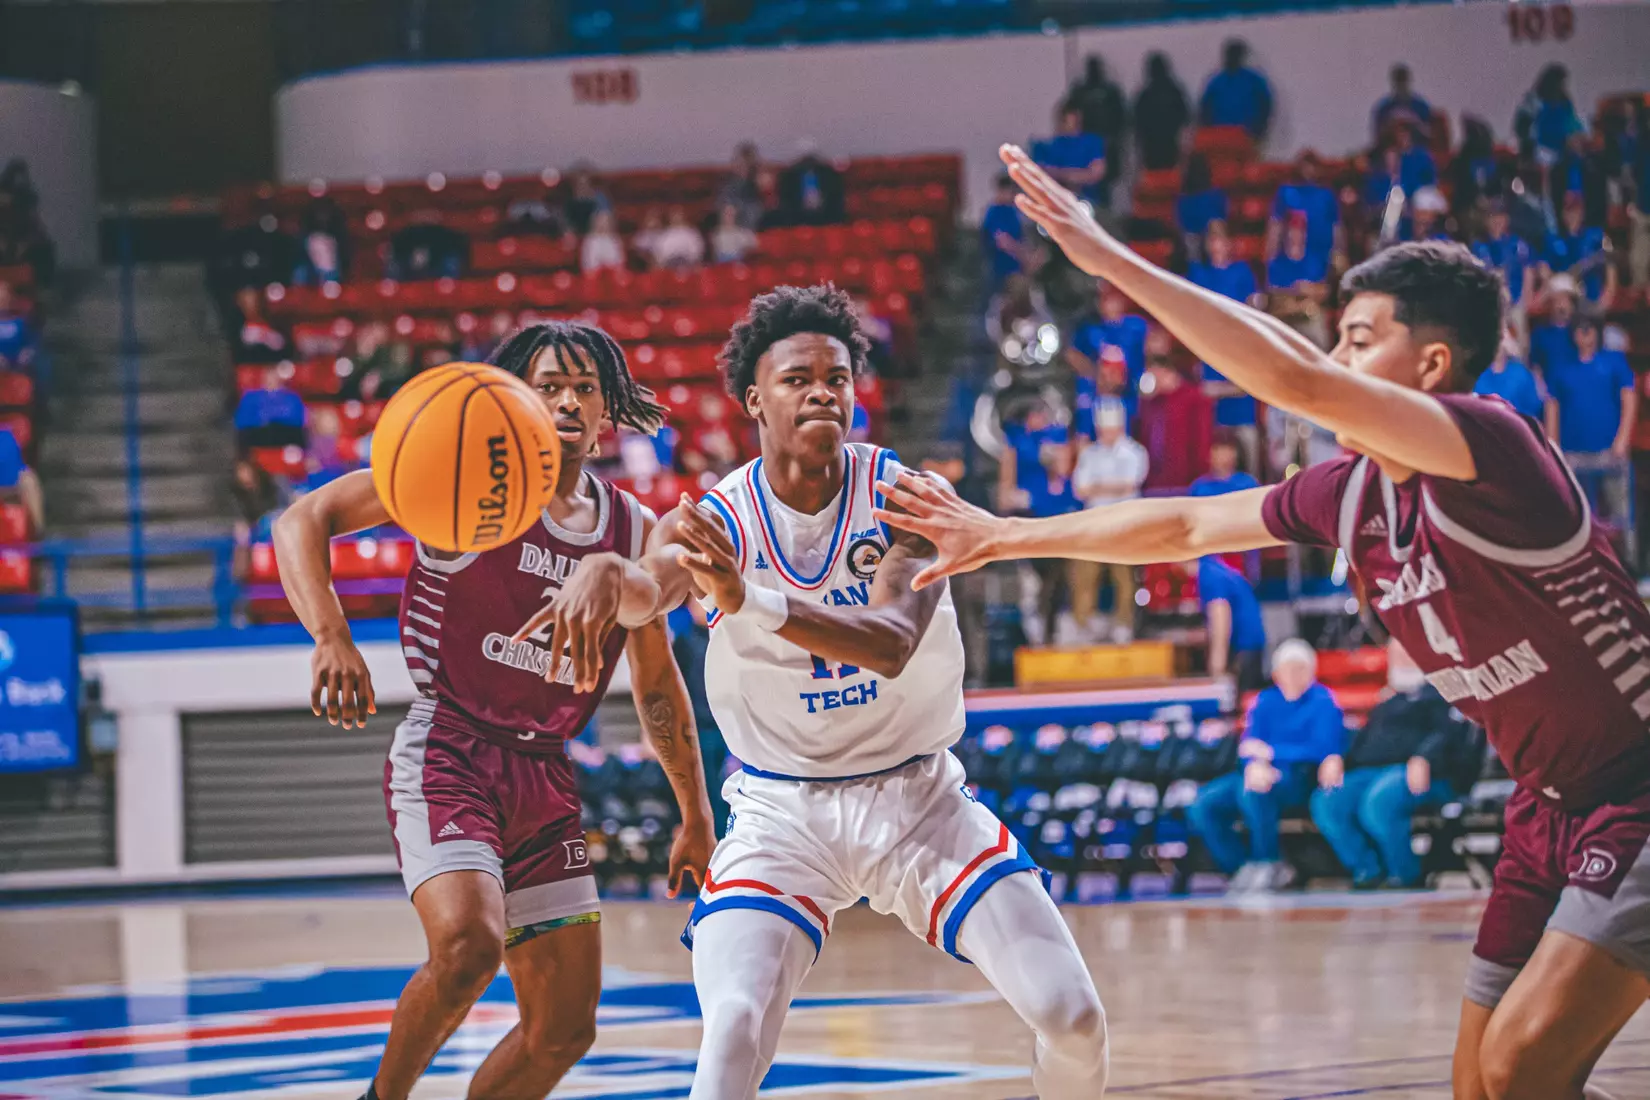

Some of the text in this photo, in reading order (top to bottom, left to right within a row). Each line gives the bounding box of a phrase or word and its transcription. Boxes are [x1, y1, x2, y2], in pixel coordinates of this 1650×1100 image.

[472, 434, 509, 546] Wilson
[1417, 602, 1464, 662] 4
[799, 679, 878, 714] TECH
